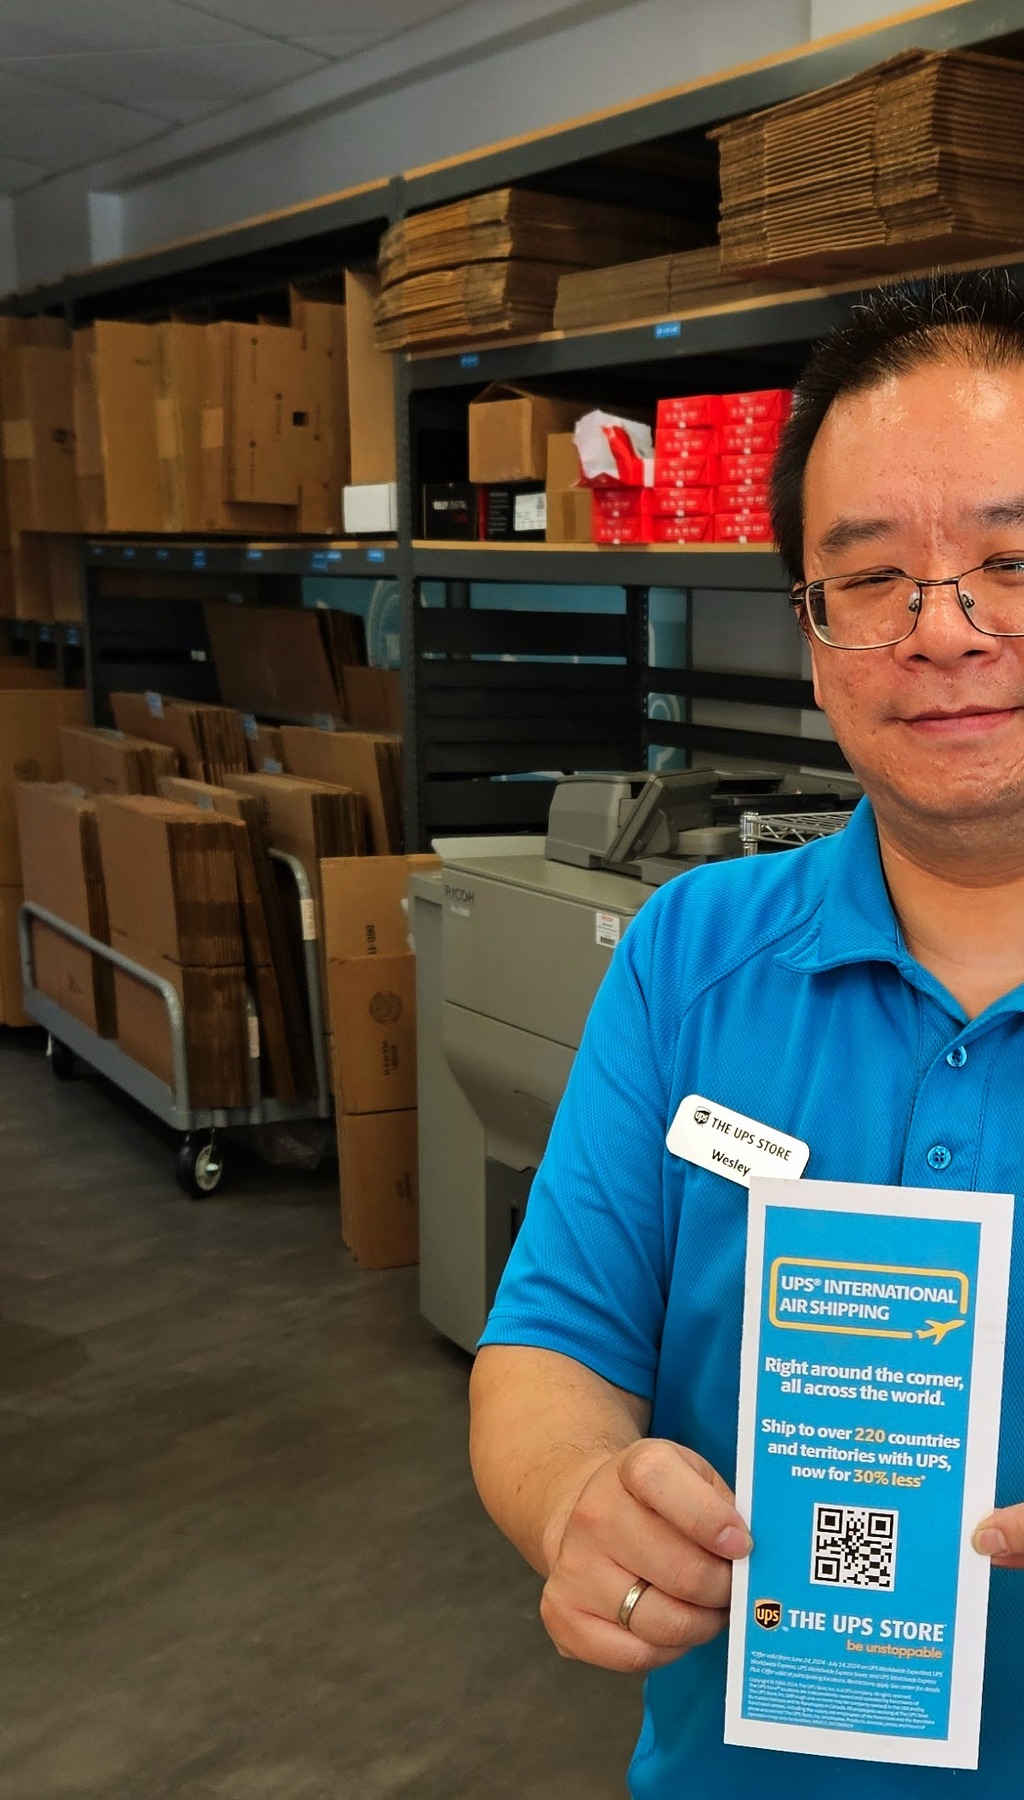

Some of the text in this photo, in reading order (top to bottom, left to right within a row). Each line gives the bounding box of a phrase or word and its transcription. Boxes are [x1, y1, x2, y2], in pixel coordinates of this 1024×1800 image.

[445, 884, 476, 903] RICOH
[712, 1117, 732, 1135] THE
[734, 1127, 756, 1144] UPS
[757, 1138, 792, 1161] STORE
[711, 1149, 751, 1177] Wesley
[824, 1278, 958, 1304] INTERNATIONAL
[779, 1297, 889, 1320] AIR SHIPPING
[764, 1357, 963, 1390] Right around the corner,
[780, 1377, 945, 1406] all across the world.
[761, 1418, 960, 1449] Ship to over 220 countries
[767, 1440, 951, 1471] and territories with UPS,
[791, 1465, 826, 1479] now
[827, 1466, 850, 1481] for
[853, 1469, 888, 1485] 30%
[756, 1608, 943, 1642] ups THE UPS STORE
[846, 1639, 942, 1660] be unstoppable
